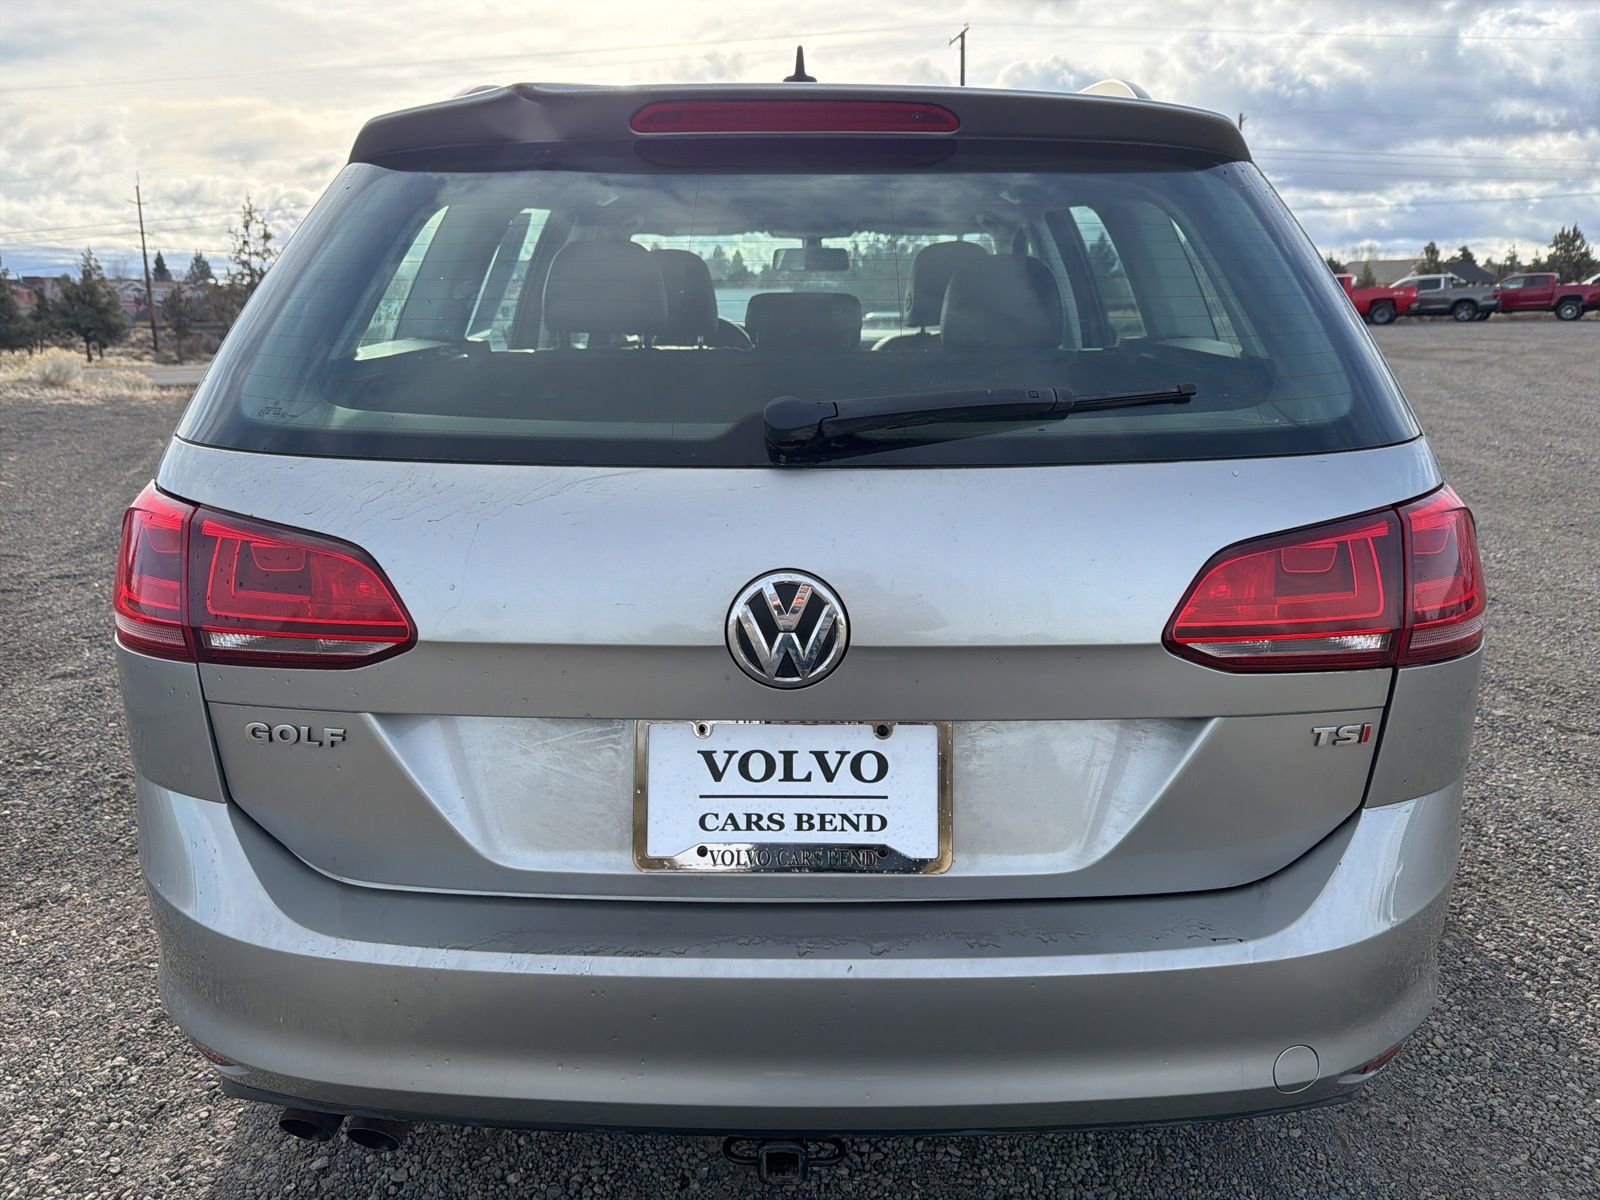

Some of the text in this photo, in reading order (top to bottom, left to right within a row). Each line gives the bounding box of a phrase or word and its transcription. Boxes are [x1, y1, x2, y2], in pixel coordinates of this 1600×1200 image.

[244, 722, 346, 747] GOLF
[1311, 722, 1373, 746] TSI
[697, 749, 889, 784] VOLVO
[698, 812, 888, 833] CARS BEND
[709, 848, 878, 868] VOLVO CARS BEND
